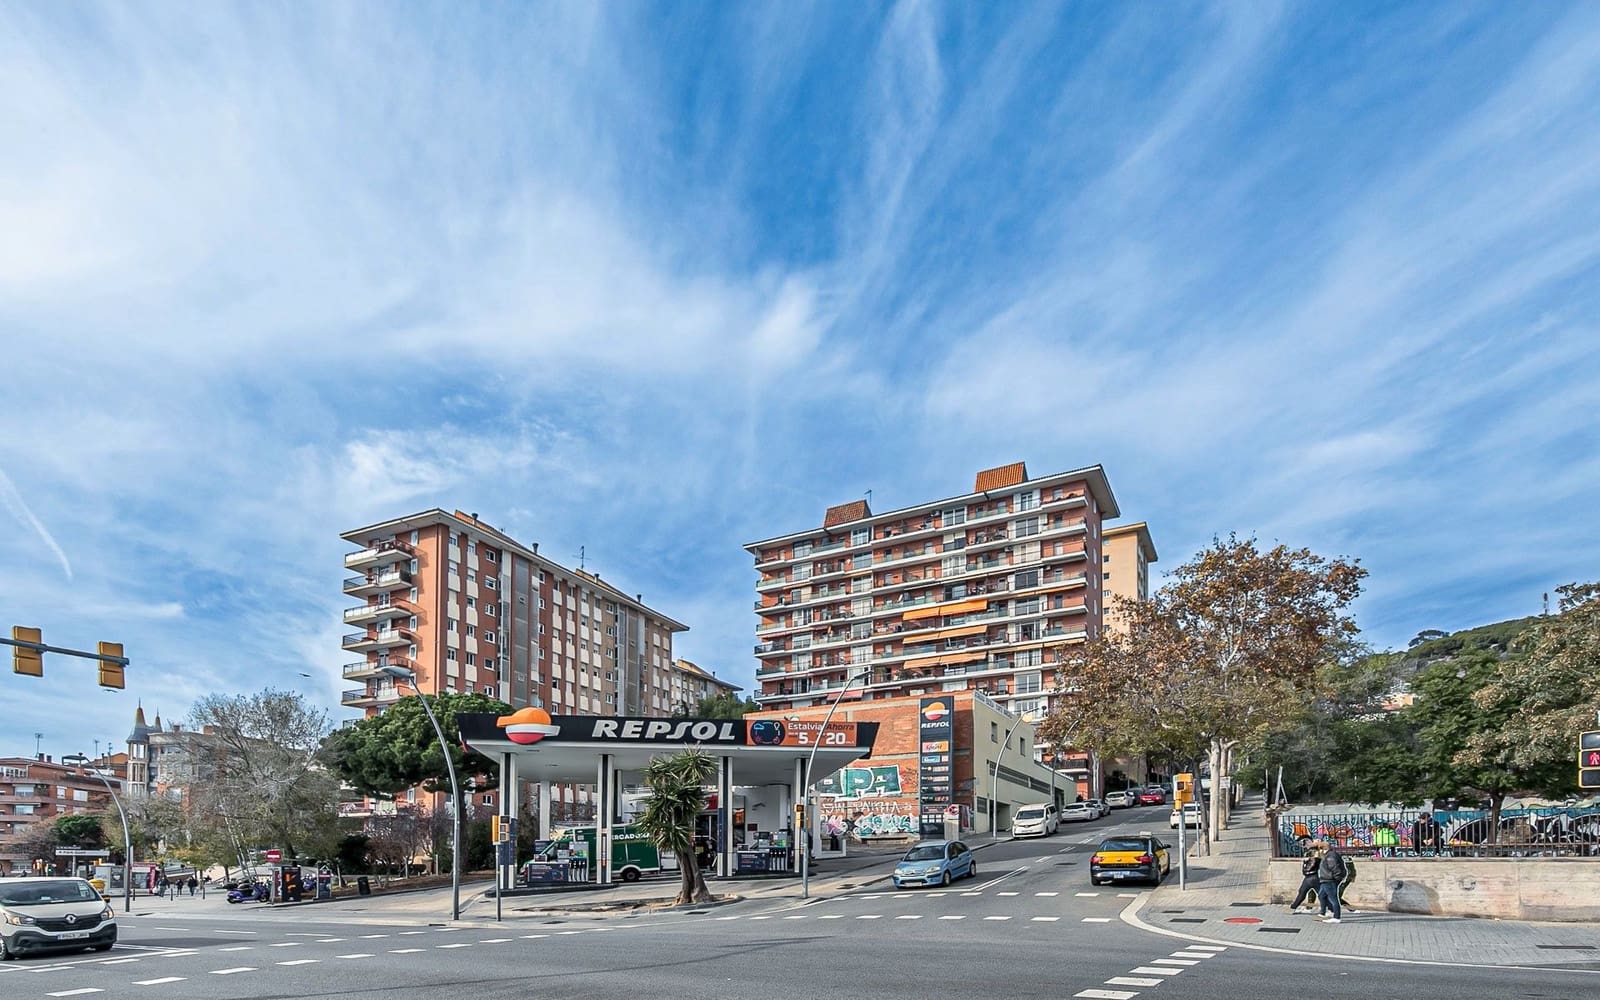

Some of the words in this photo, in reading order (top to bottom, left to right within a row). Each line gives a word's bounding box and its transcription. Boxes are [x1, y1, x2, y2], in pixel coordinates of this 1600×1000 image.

[591, 719, 736, 740] REPSOL
[788, 722, 824, 731] Estalvia
[826, 723, 855, 731] Ahorra
[921, 721, 950, 729] REPSOL
[798, 731, 809, 745] 5
[825, 731, 846, 745] 20
